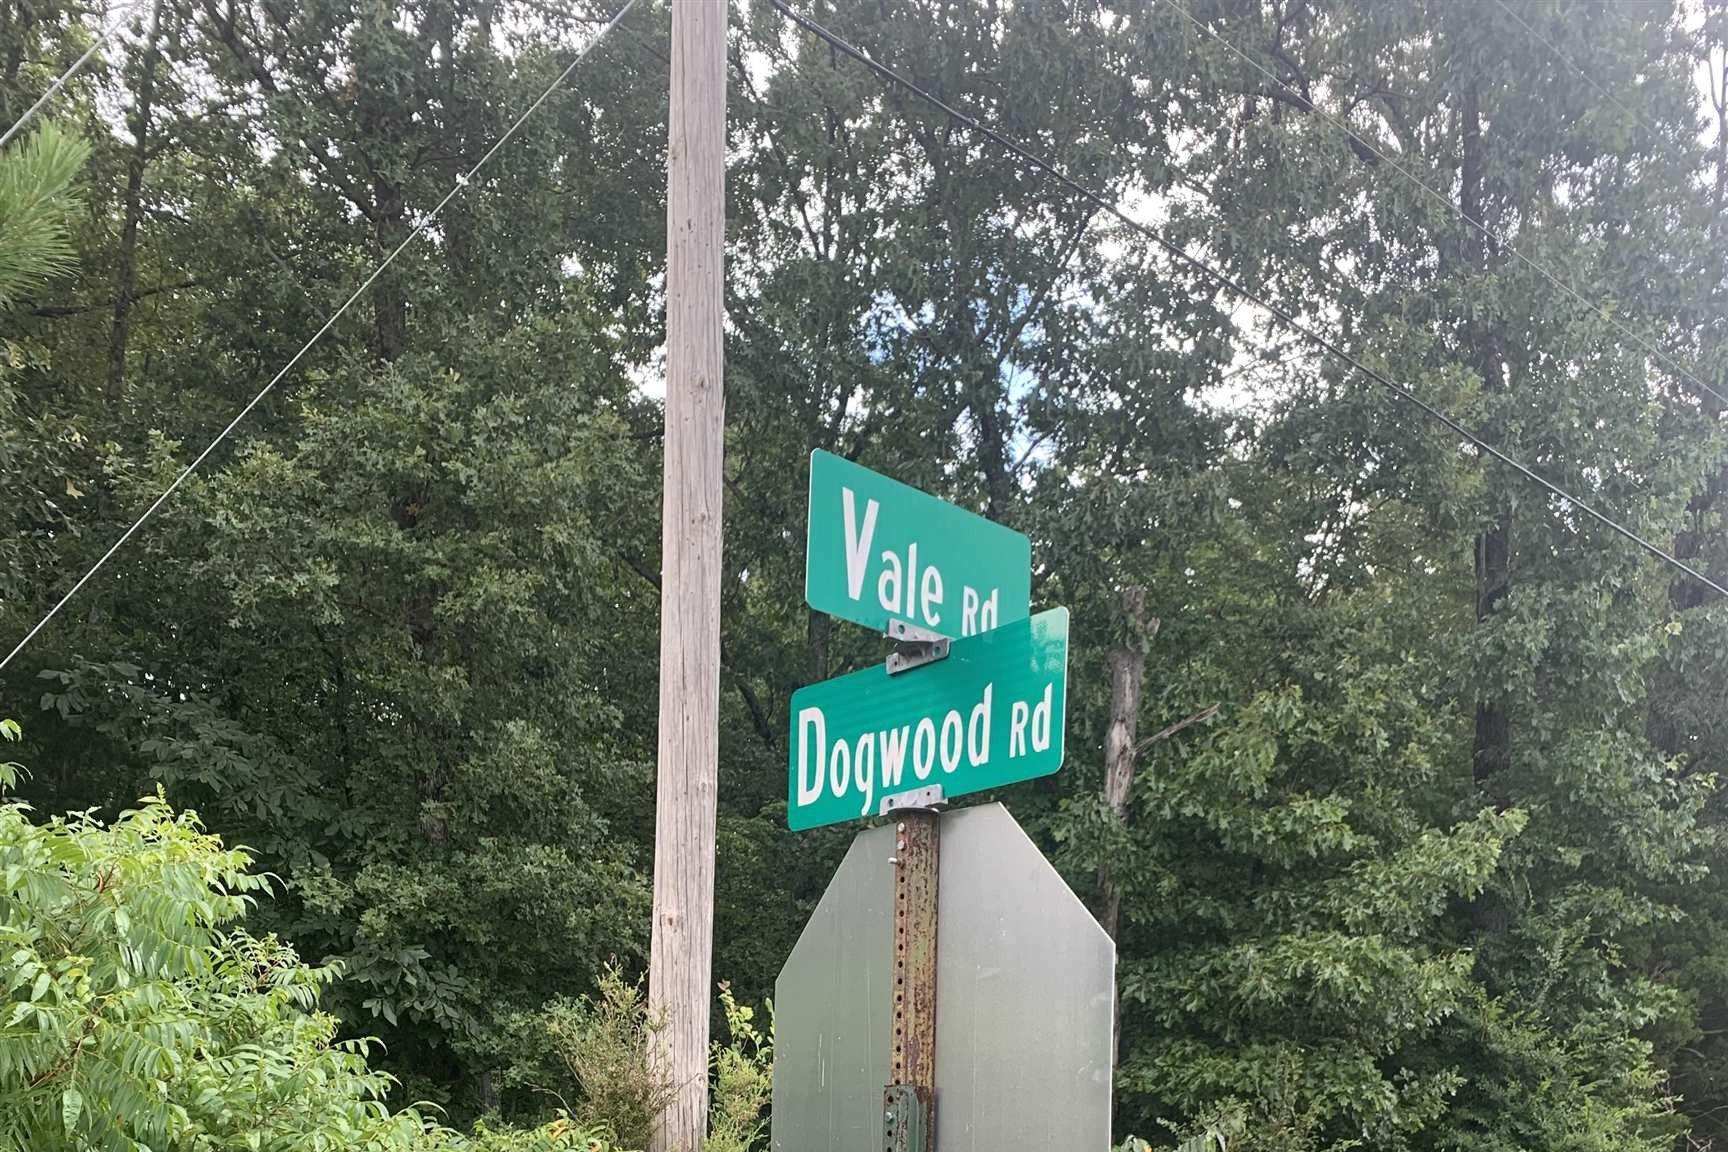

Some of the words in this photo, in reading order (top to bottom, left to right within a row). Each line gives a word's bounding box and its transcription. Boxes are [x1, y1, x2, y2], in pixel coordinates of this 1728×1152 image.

[842, 486, 943, 627] Vale
[962, 584, 998, 638] Rd
[797, 682, 993, 816] Dogwood
[1009, 682, 1053, 759] Rd
